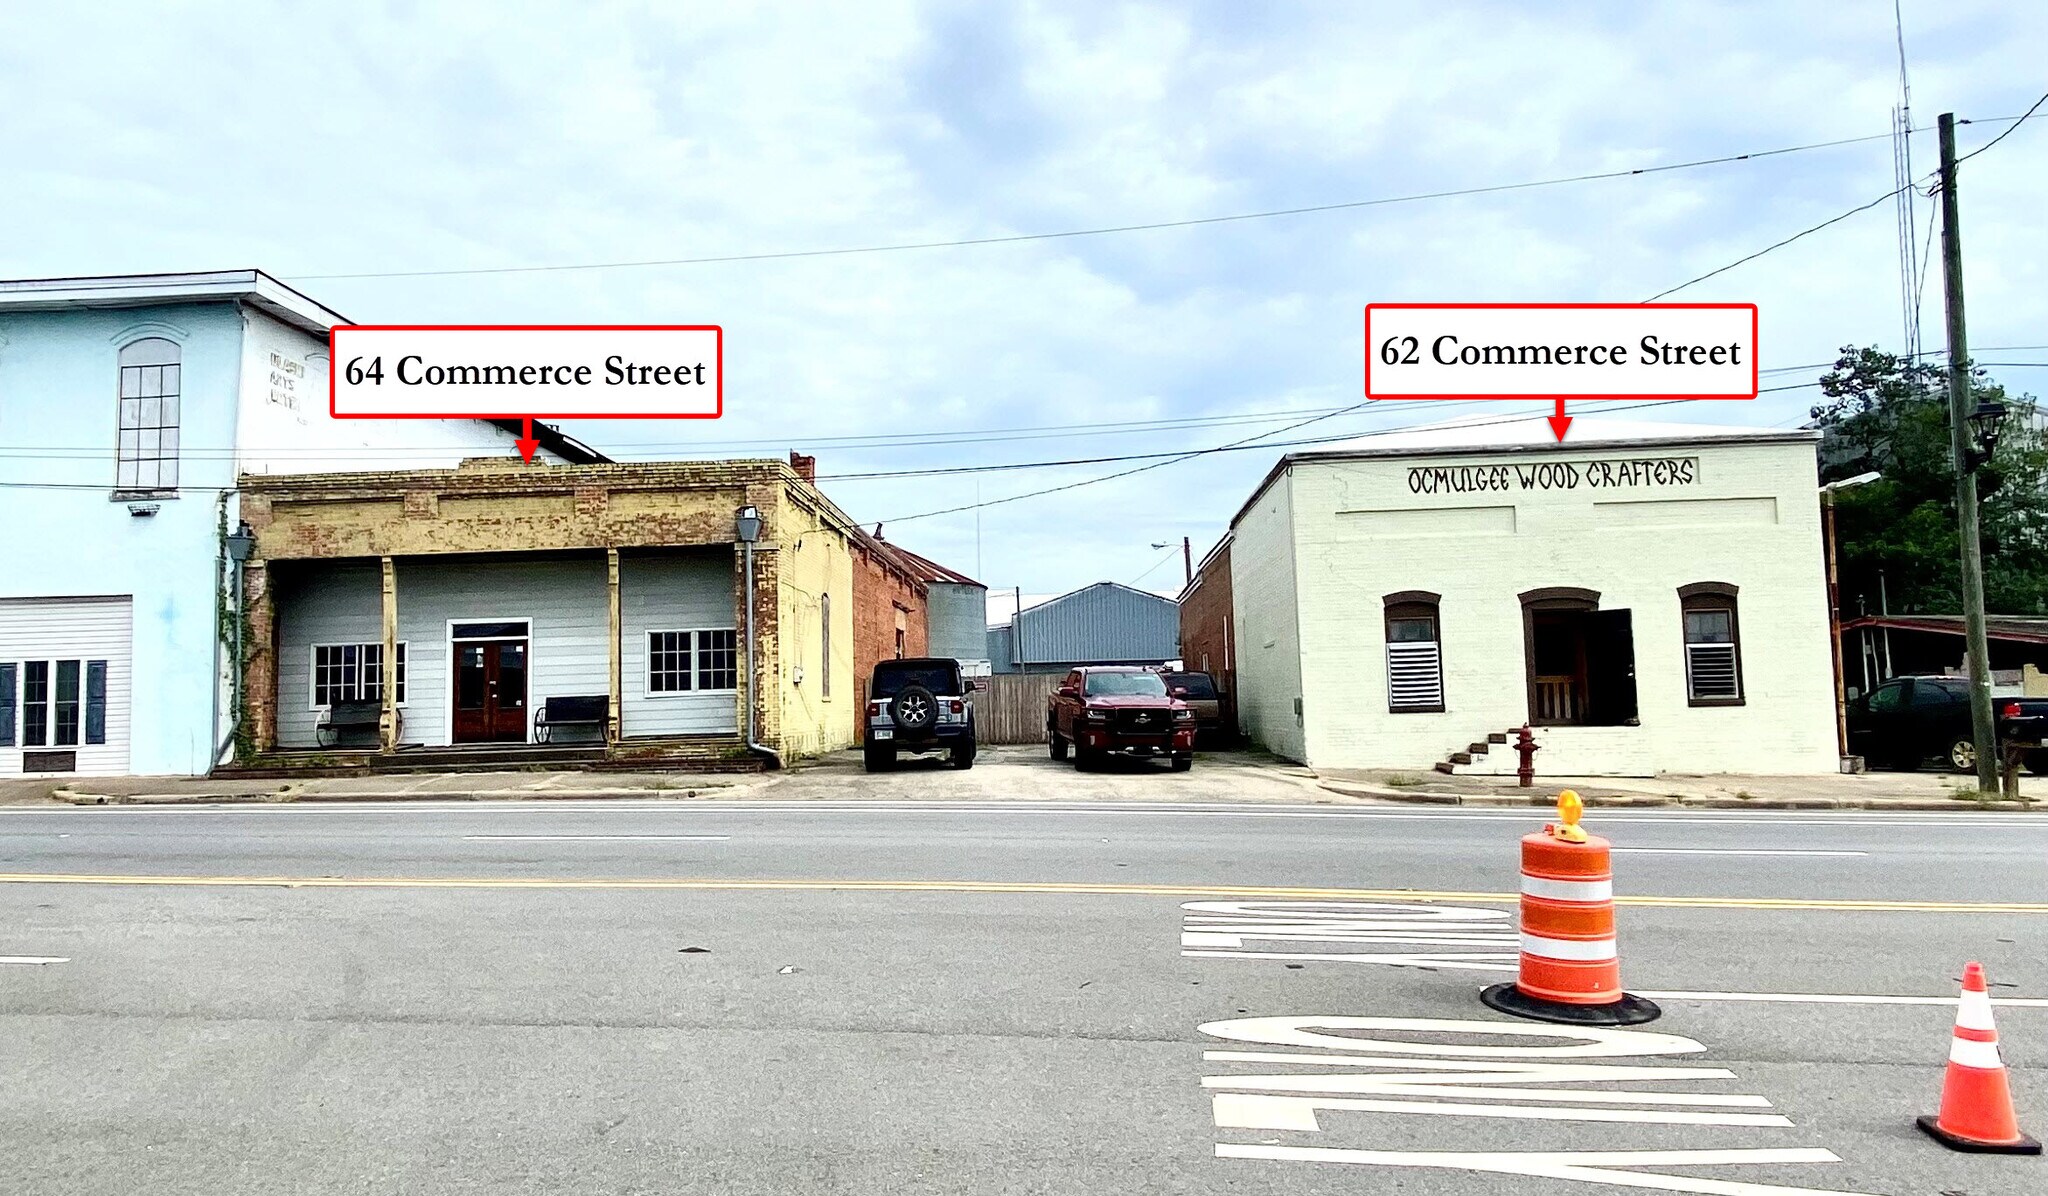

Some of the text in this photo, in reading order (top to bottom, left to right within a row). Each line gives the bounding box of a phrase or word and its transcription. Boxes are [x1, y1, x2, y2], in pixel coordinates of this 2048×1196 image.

[1408, 459, 1695, 494] OCMULGEE WOOD CRAFTERS
